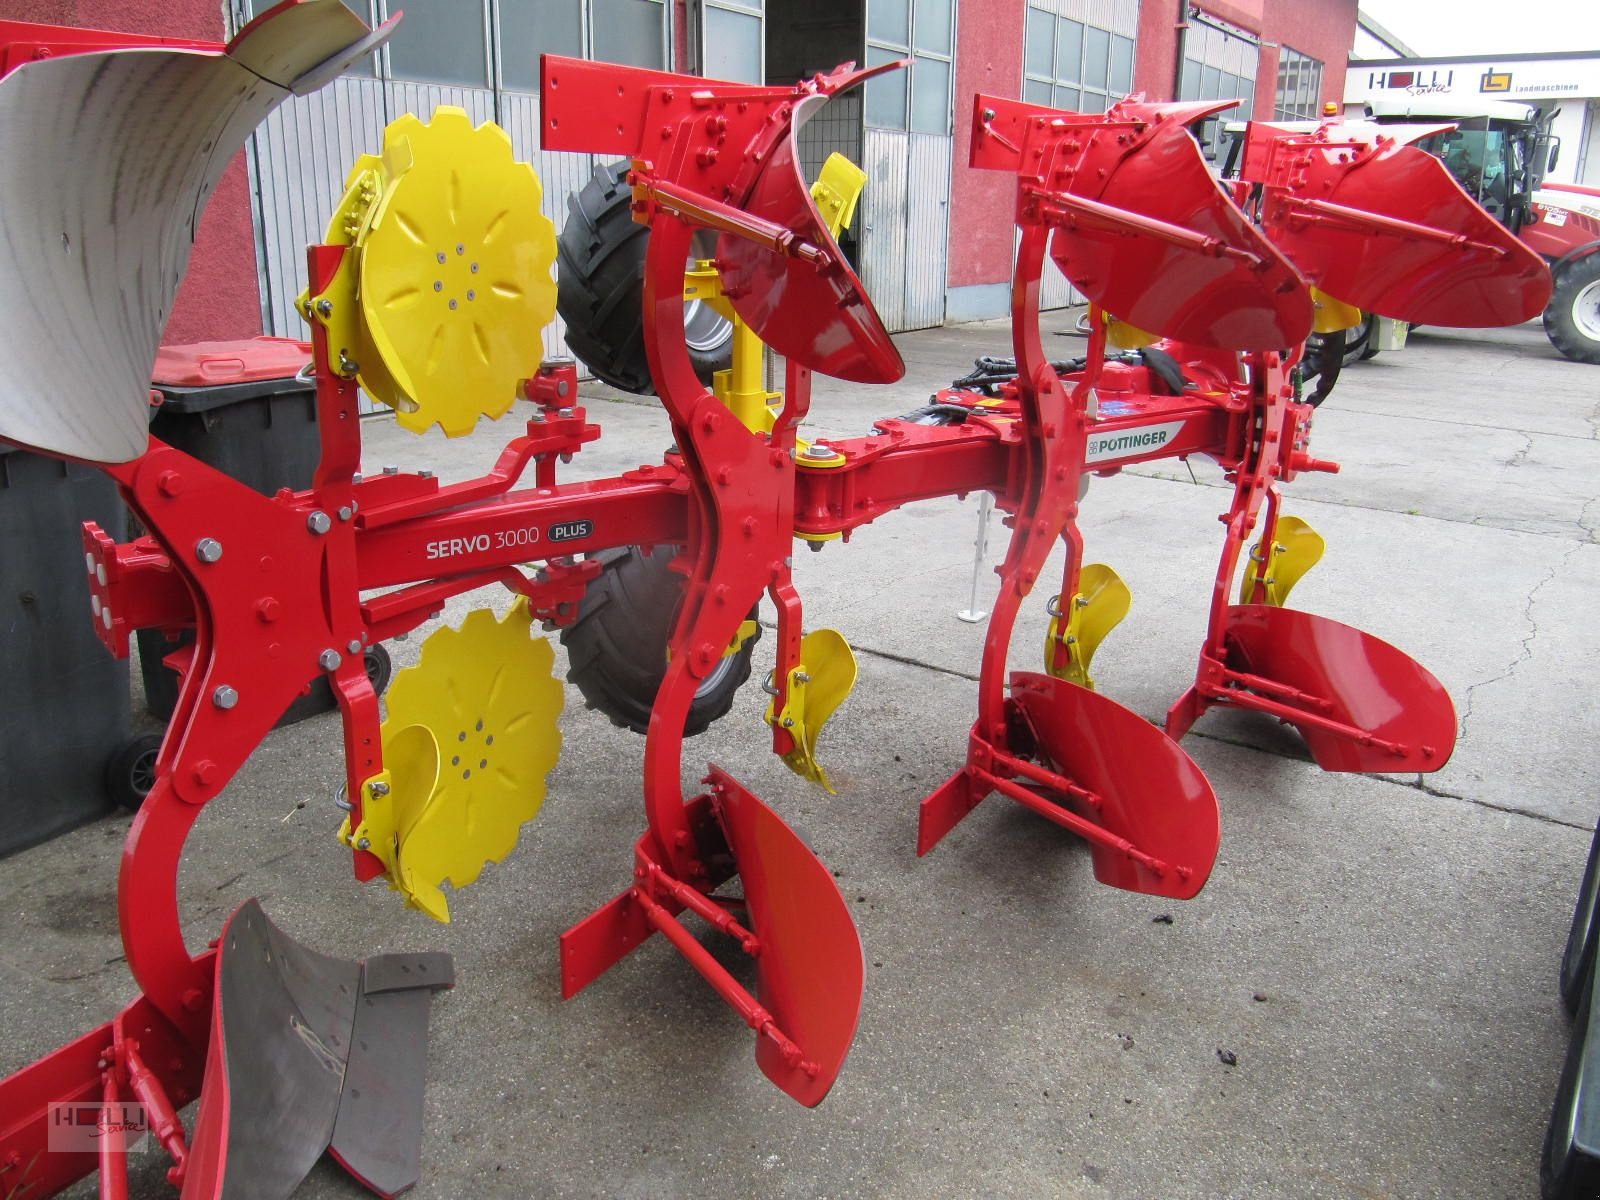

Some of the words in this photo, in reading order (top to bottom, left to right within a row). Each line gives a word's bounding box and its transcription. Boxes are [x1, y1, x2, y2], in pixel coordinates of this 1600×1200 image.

[426, 534, 491, 560] SERVO
[494, 527, 540, 549] 3000
[555, 523, 587, 539] PLUS
